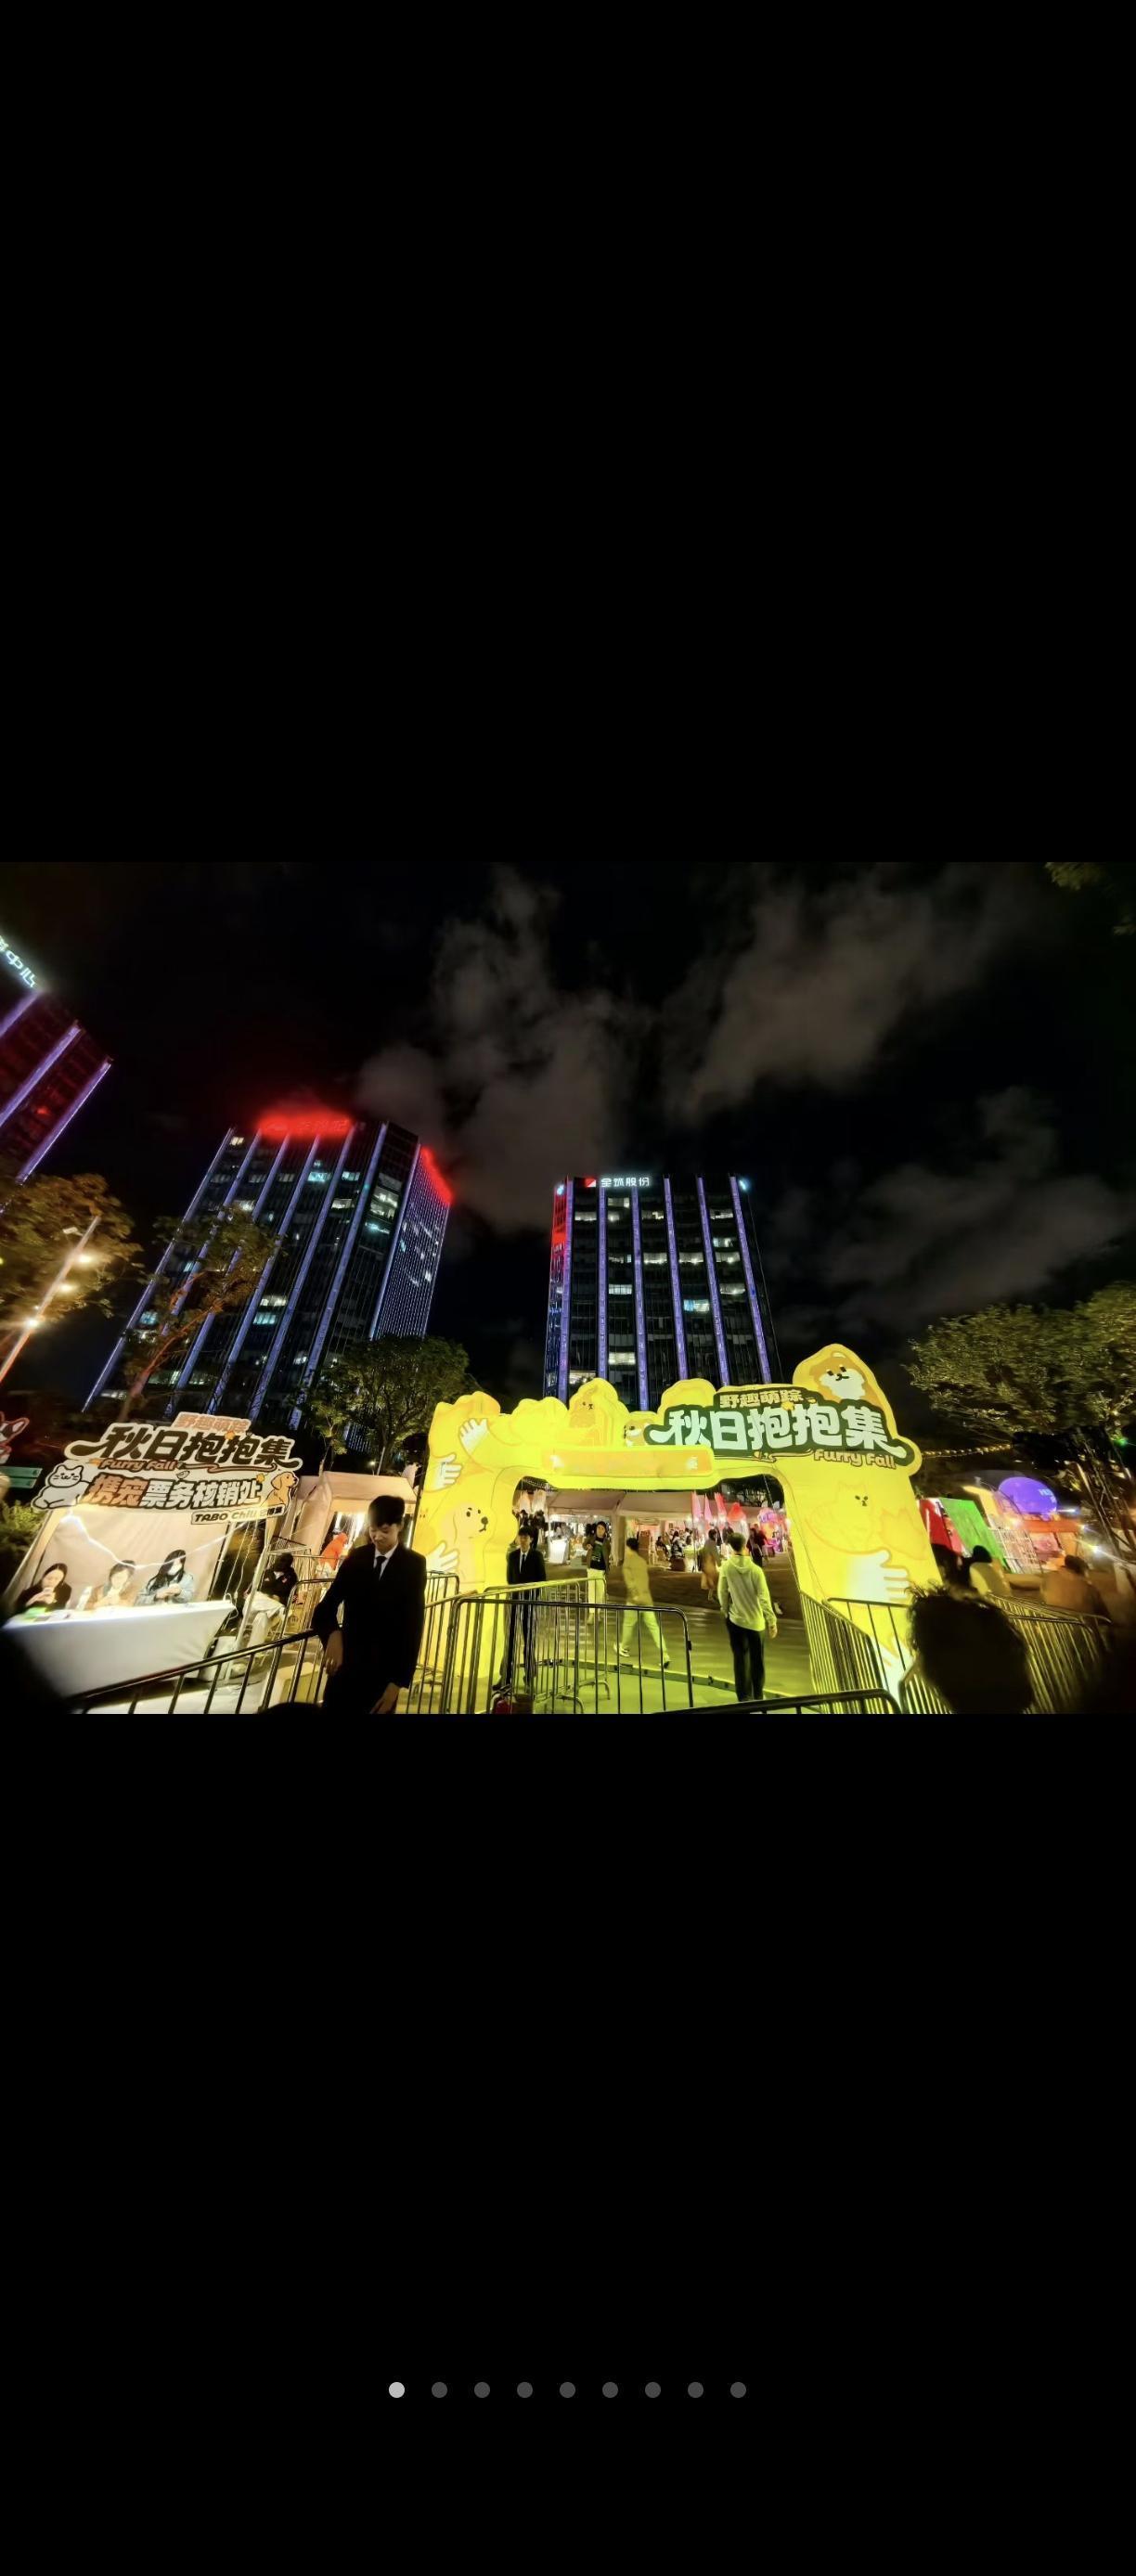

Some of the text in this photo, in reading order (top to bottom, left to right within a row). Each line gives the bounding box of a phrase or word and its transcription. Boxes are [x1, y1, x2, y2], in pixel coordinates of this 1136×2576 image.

[719, 1390, 804, 1409] 野趣萌踪
[650, 1404, 907, 1459] 秋日抱抱集
[71, 1426, 300, 1469] 秋日抱抱集
[99, 1458, 178, 1472] Furry Fall
[814, 1449, 897, 1469] Furry Fall
